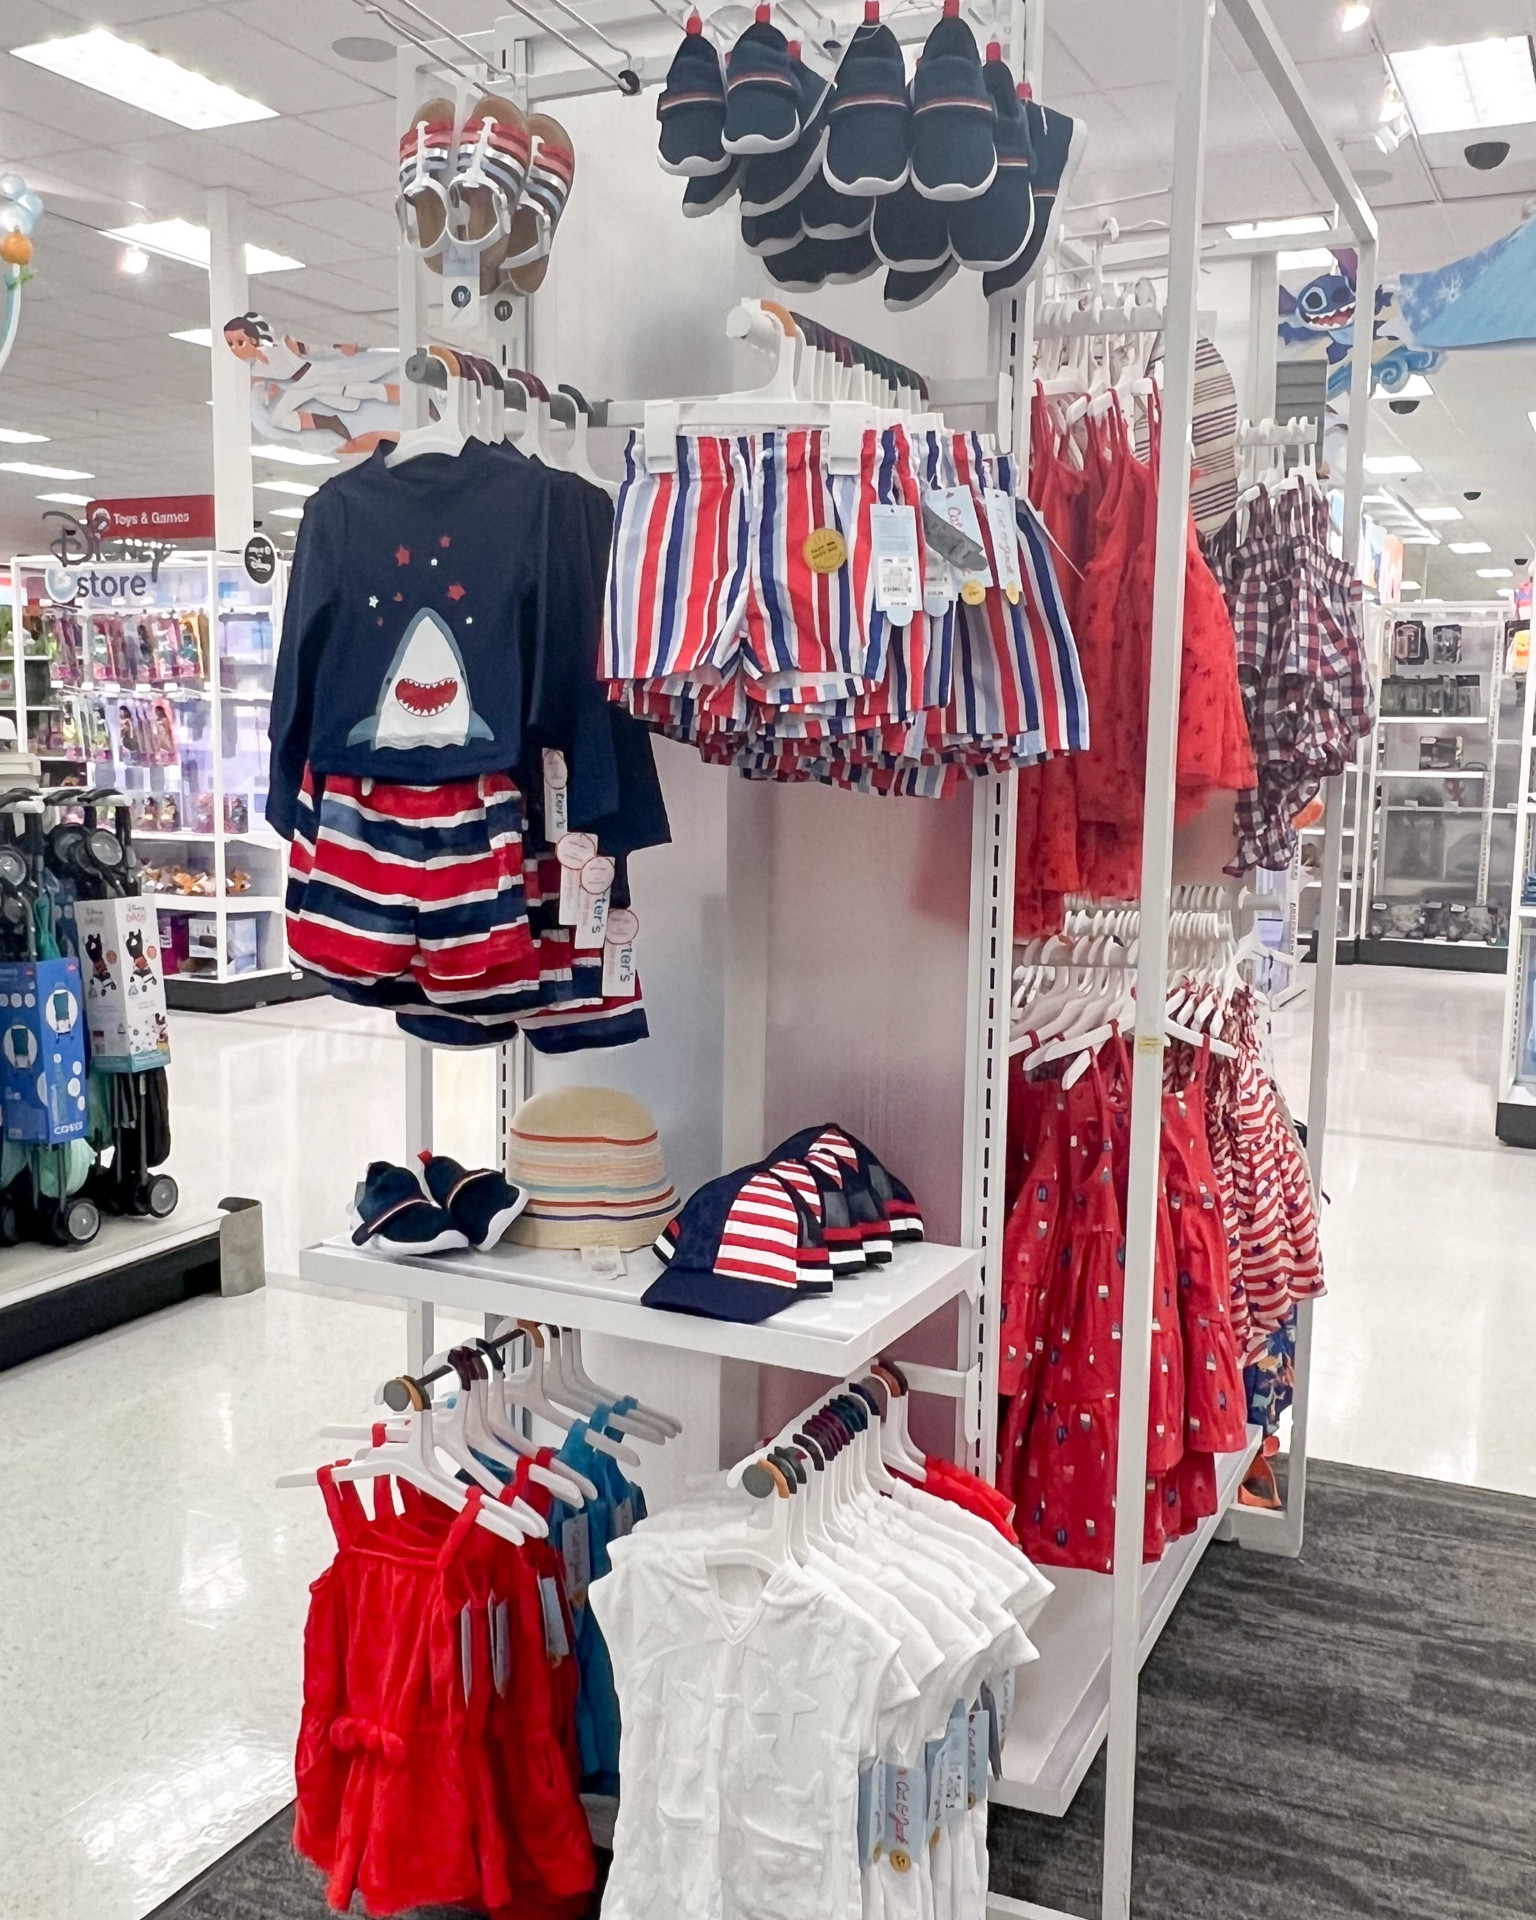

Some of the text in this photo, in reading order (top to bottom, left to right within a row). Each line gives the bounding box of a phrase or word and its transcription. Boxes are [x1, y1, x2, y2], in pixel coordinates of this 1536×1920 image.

[113, 512, 190, 527] Toys & Games
[77, 571, 146, 597] store
[592, 894, 608, 934] ter's
